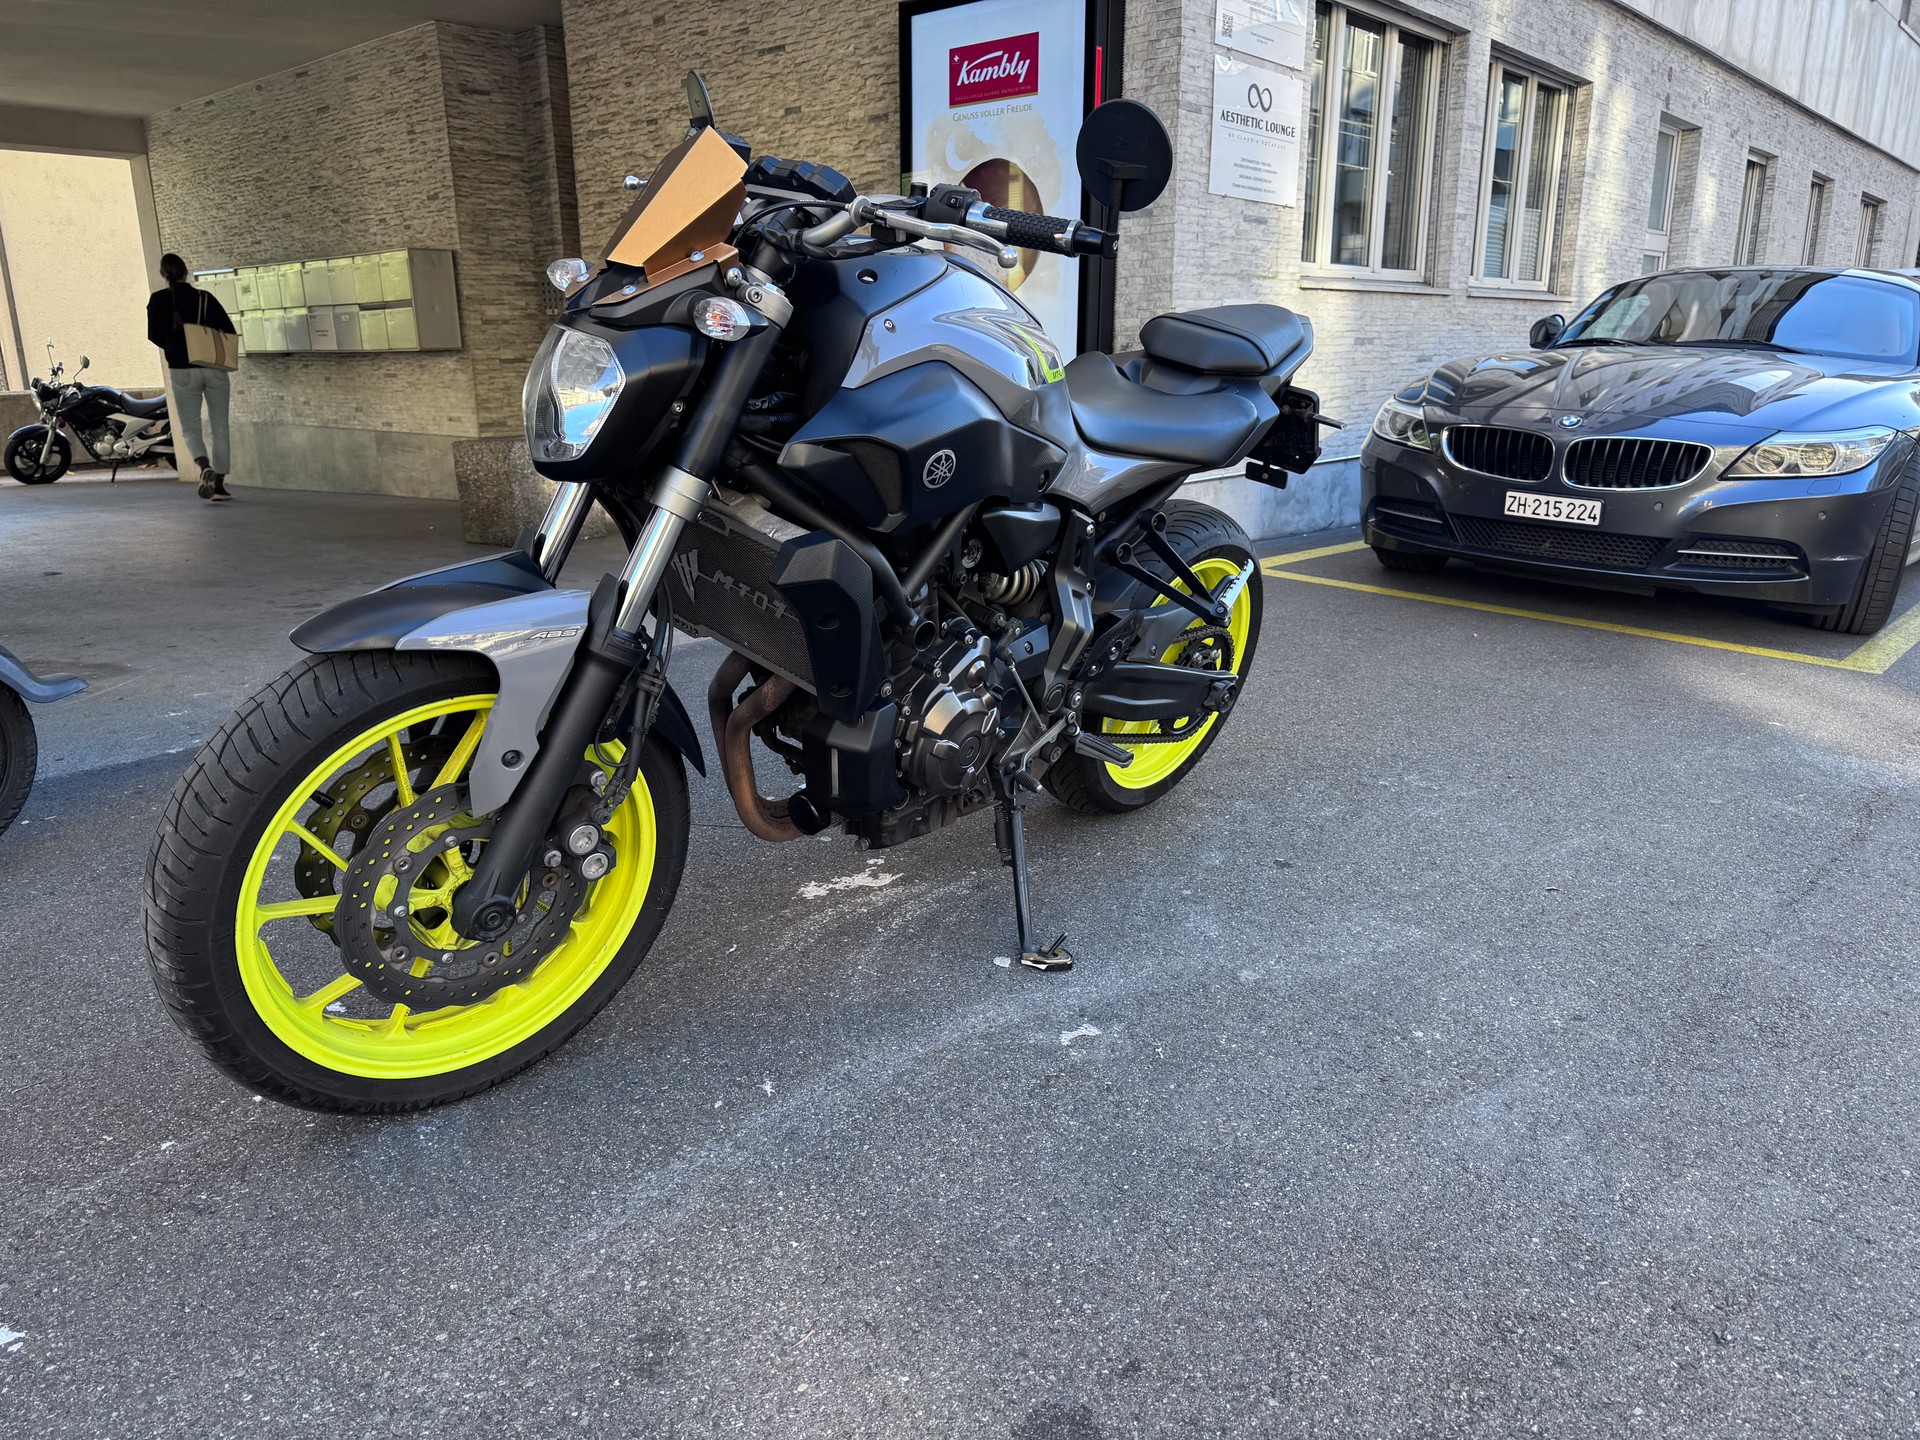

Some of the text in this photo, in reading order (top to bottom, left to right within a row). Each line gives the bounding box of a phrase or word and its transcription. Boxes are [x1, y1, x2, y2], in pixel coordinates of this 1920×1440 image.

[956, 50, 1031, 87] Kambly
[952, 103, 1033, 122] GENUSS VOLLER FREUDE
[1220, 109, 1296, 138] AESTHETIC LOUNGE
[526, 627, 579, 640] ABS
